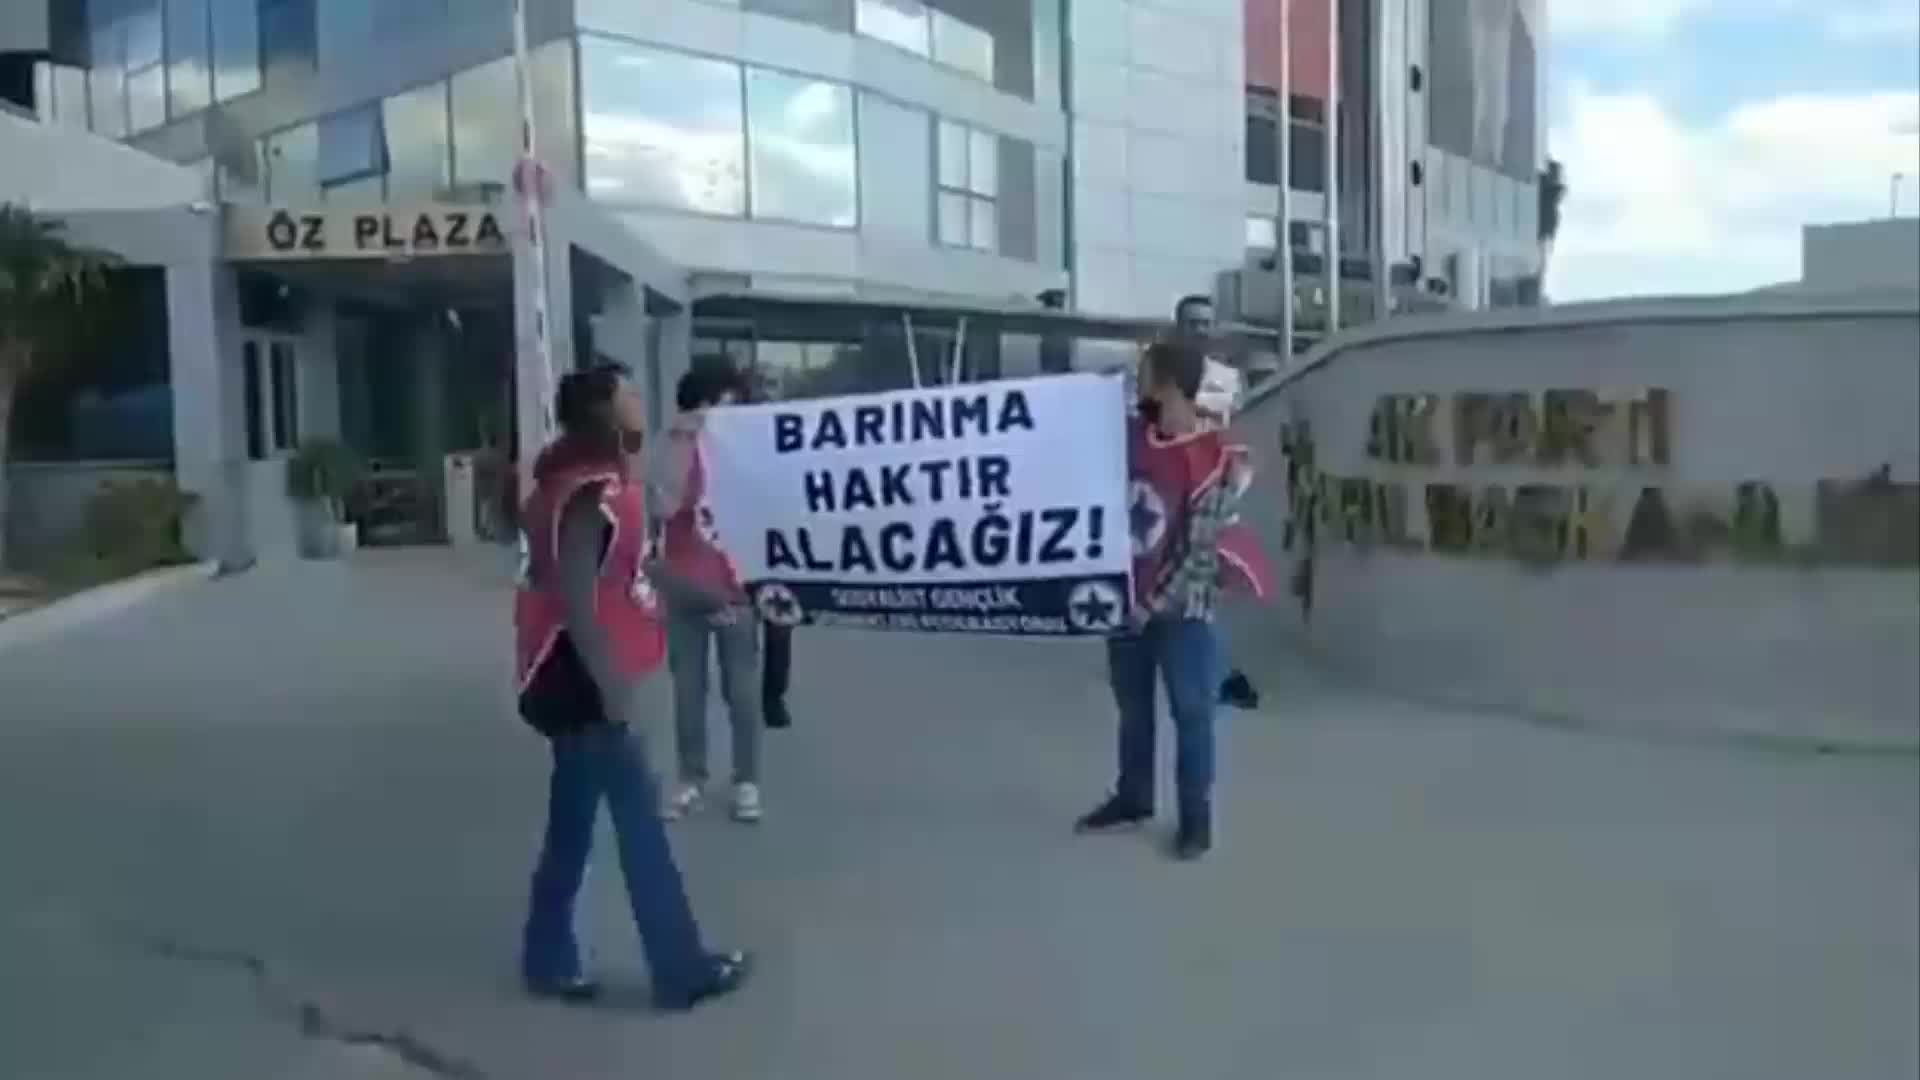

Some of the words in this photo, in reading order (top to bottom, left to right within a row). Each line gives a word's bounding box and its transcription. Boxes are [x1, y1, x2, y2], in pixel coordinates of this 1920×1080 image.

[354, 212, 505, 249] PLAZA
[774, 390, 1035, 454] BARINMA
[804, 455, 1012, 513] HAKTIR
[764, 503, 1105, 574] ALACAĞIZ!
